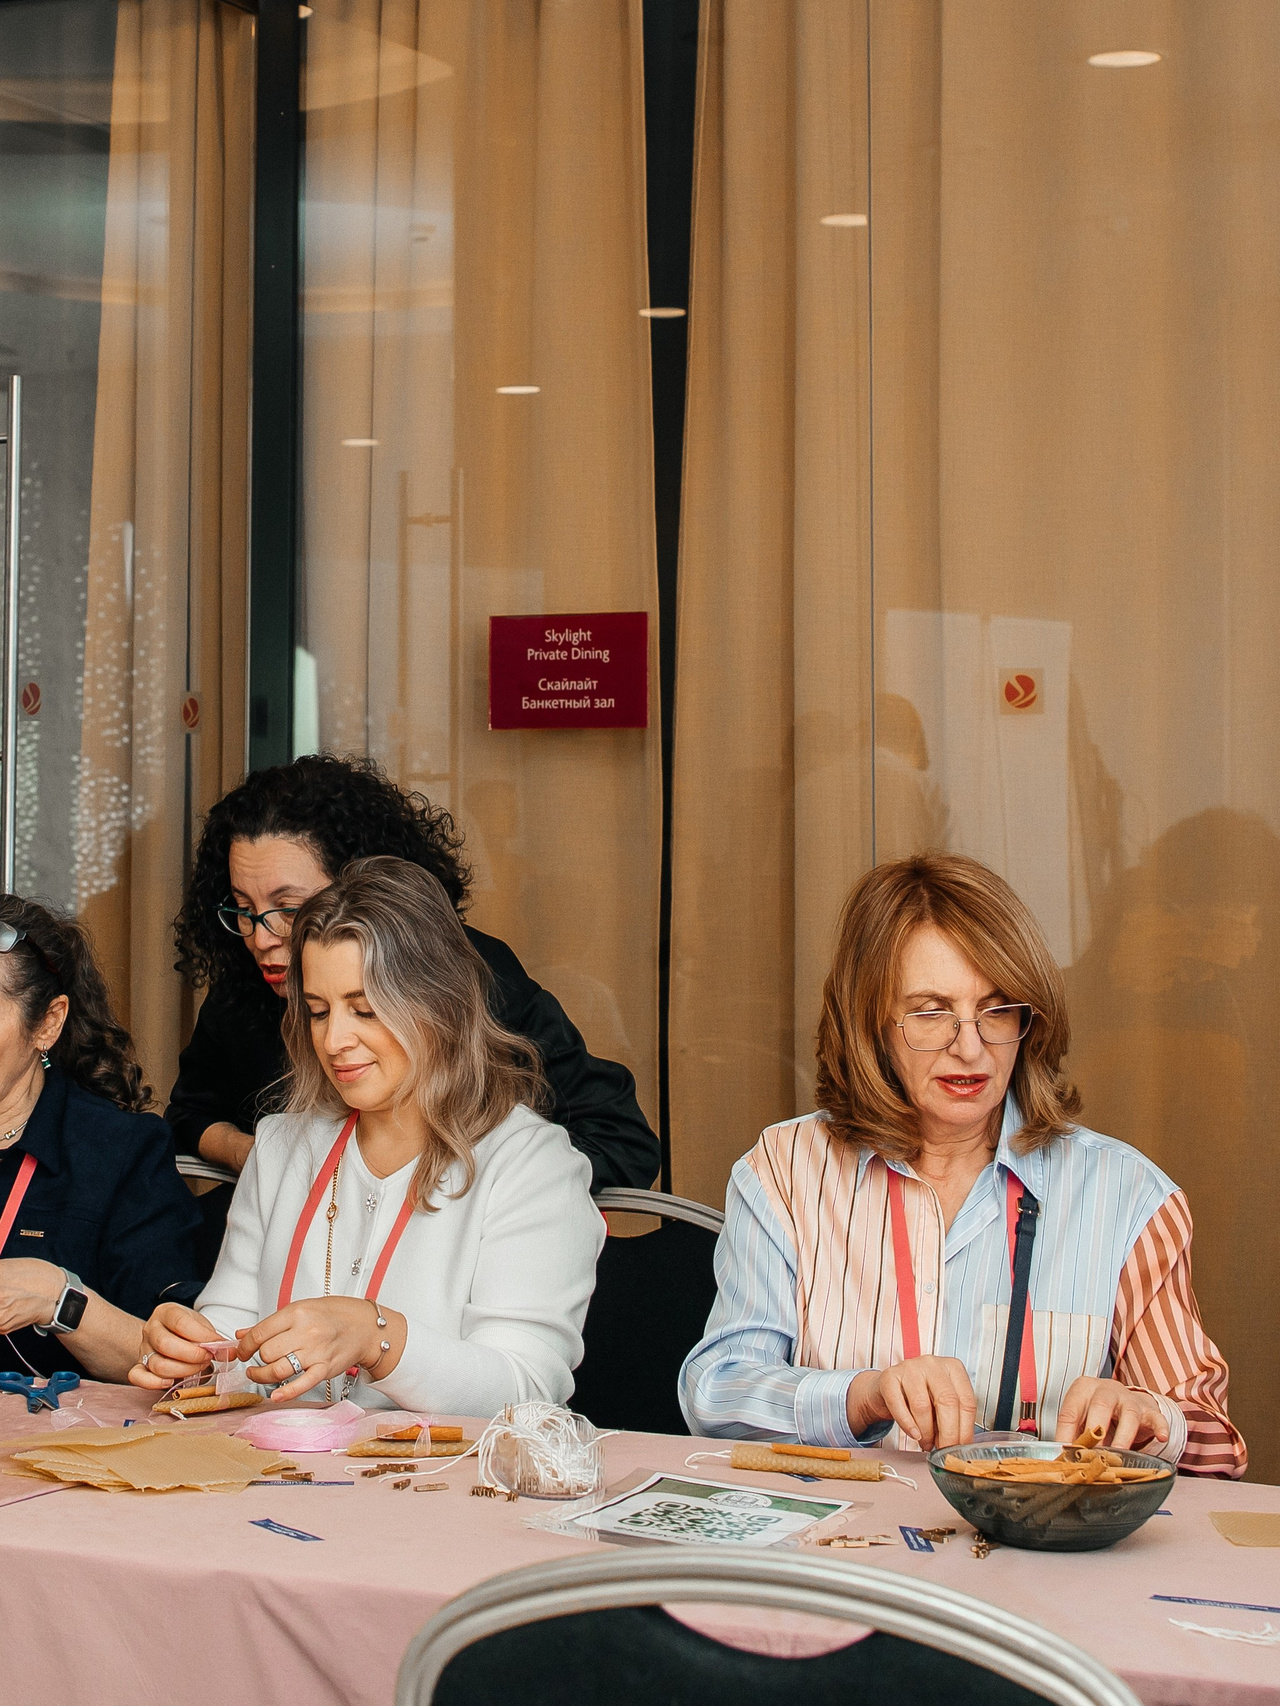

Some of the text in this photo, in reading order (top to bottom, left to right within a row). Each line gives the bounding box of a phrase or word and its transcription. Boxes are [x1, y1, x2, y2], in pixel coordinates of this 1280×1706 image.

[544, 628, 592, 645] Skylight
[527, 647, 610, 663] Private Dining
[537, 678, 598, 691] Скайлайт
[521, 696, 615, 710] Банкетный зал
